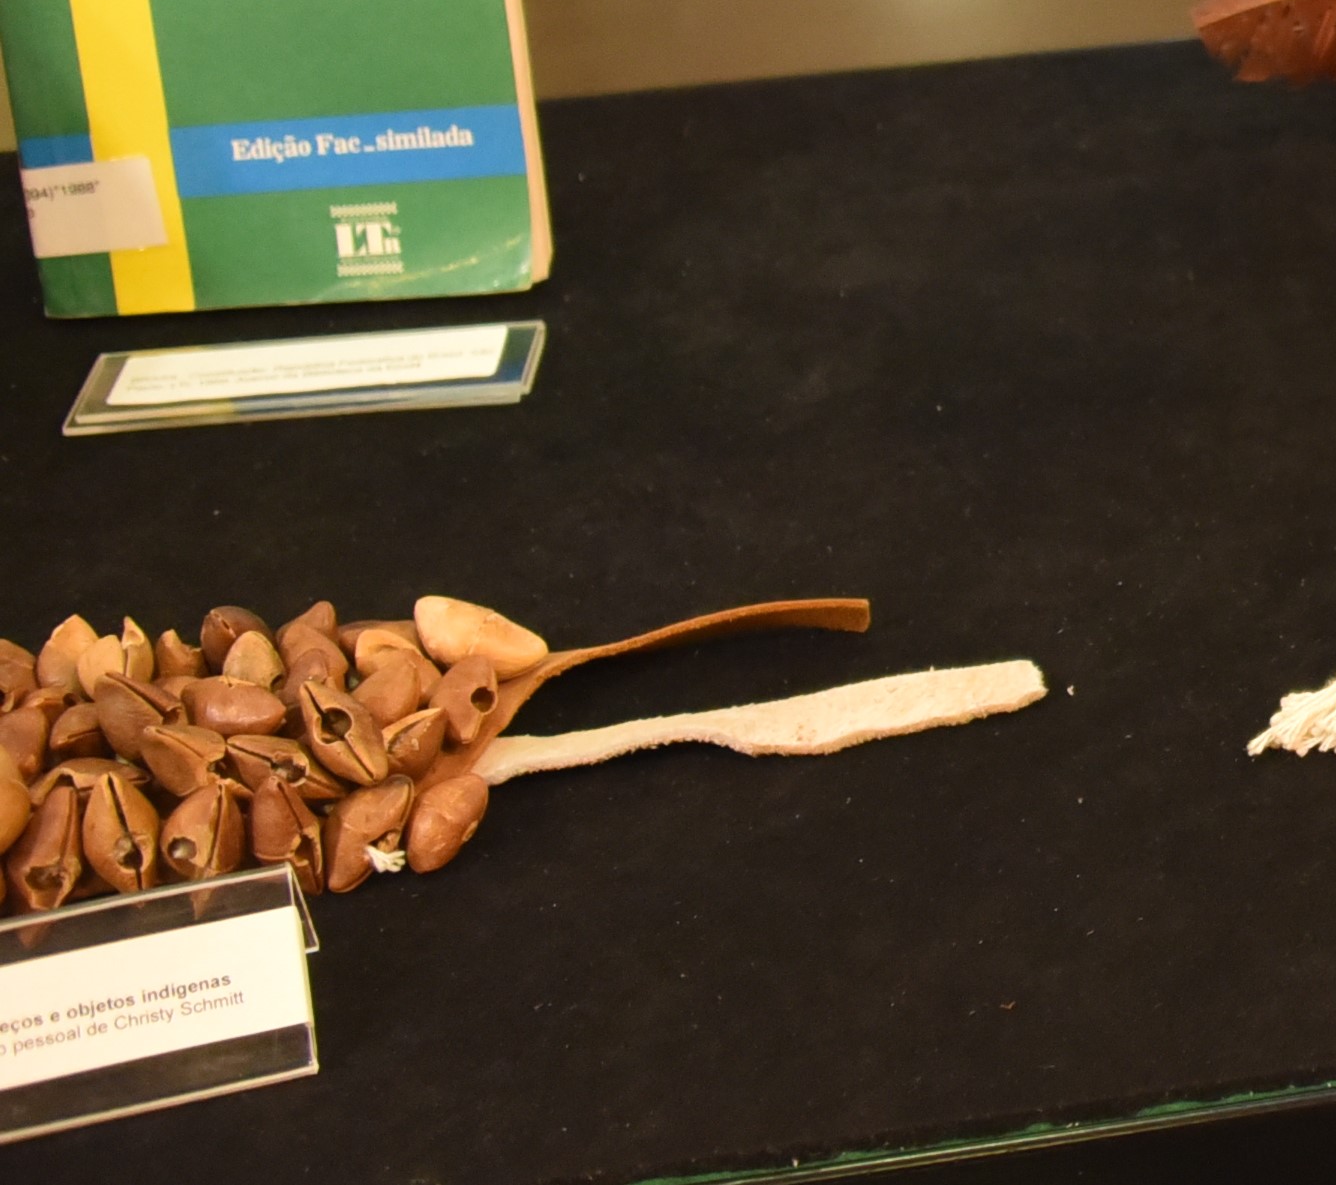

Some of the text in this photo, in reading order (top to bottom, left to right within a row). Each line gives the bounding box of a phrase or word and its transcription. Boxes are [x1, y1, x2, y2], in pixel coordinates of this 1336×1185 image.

[231, 134, 311, 163] Edição
[0, 1014, 44, 1035] eços
[50, 1012, 60, 1023] e
[66, 993, 136, 1019] objetos
[13, 1025, 81, 1057] pessoal
[87, 1022, 108, 1037] de
[114, 1006, 175, 1032] Christy
[180, 991, 245, 1017] Schmitt
